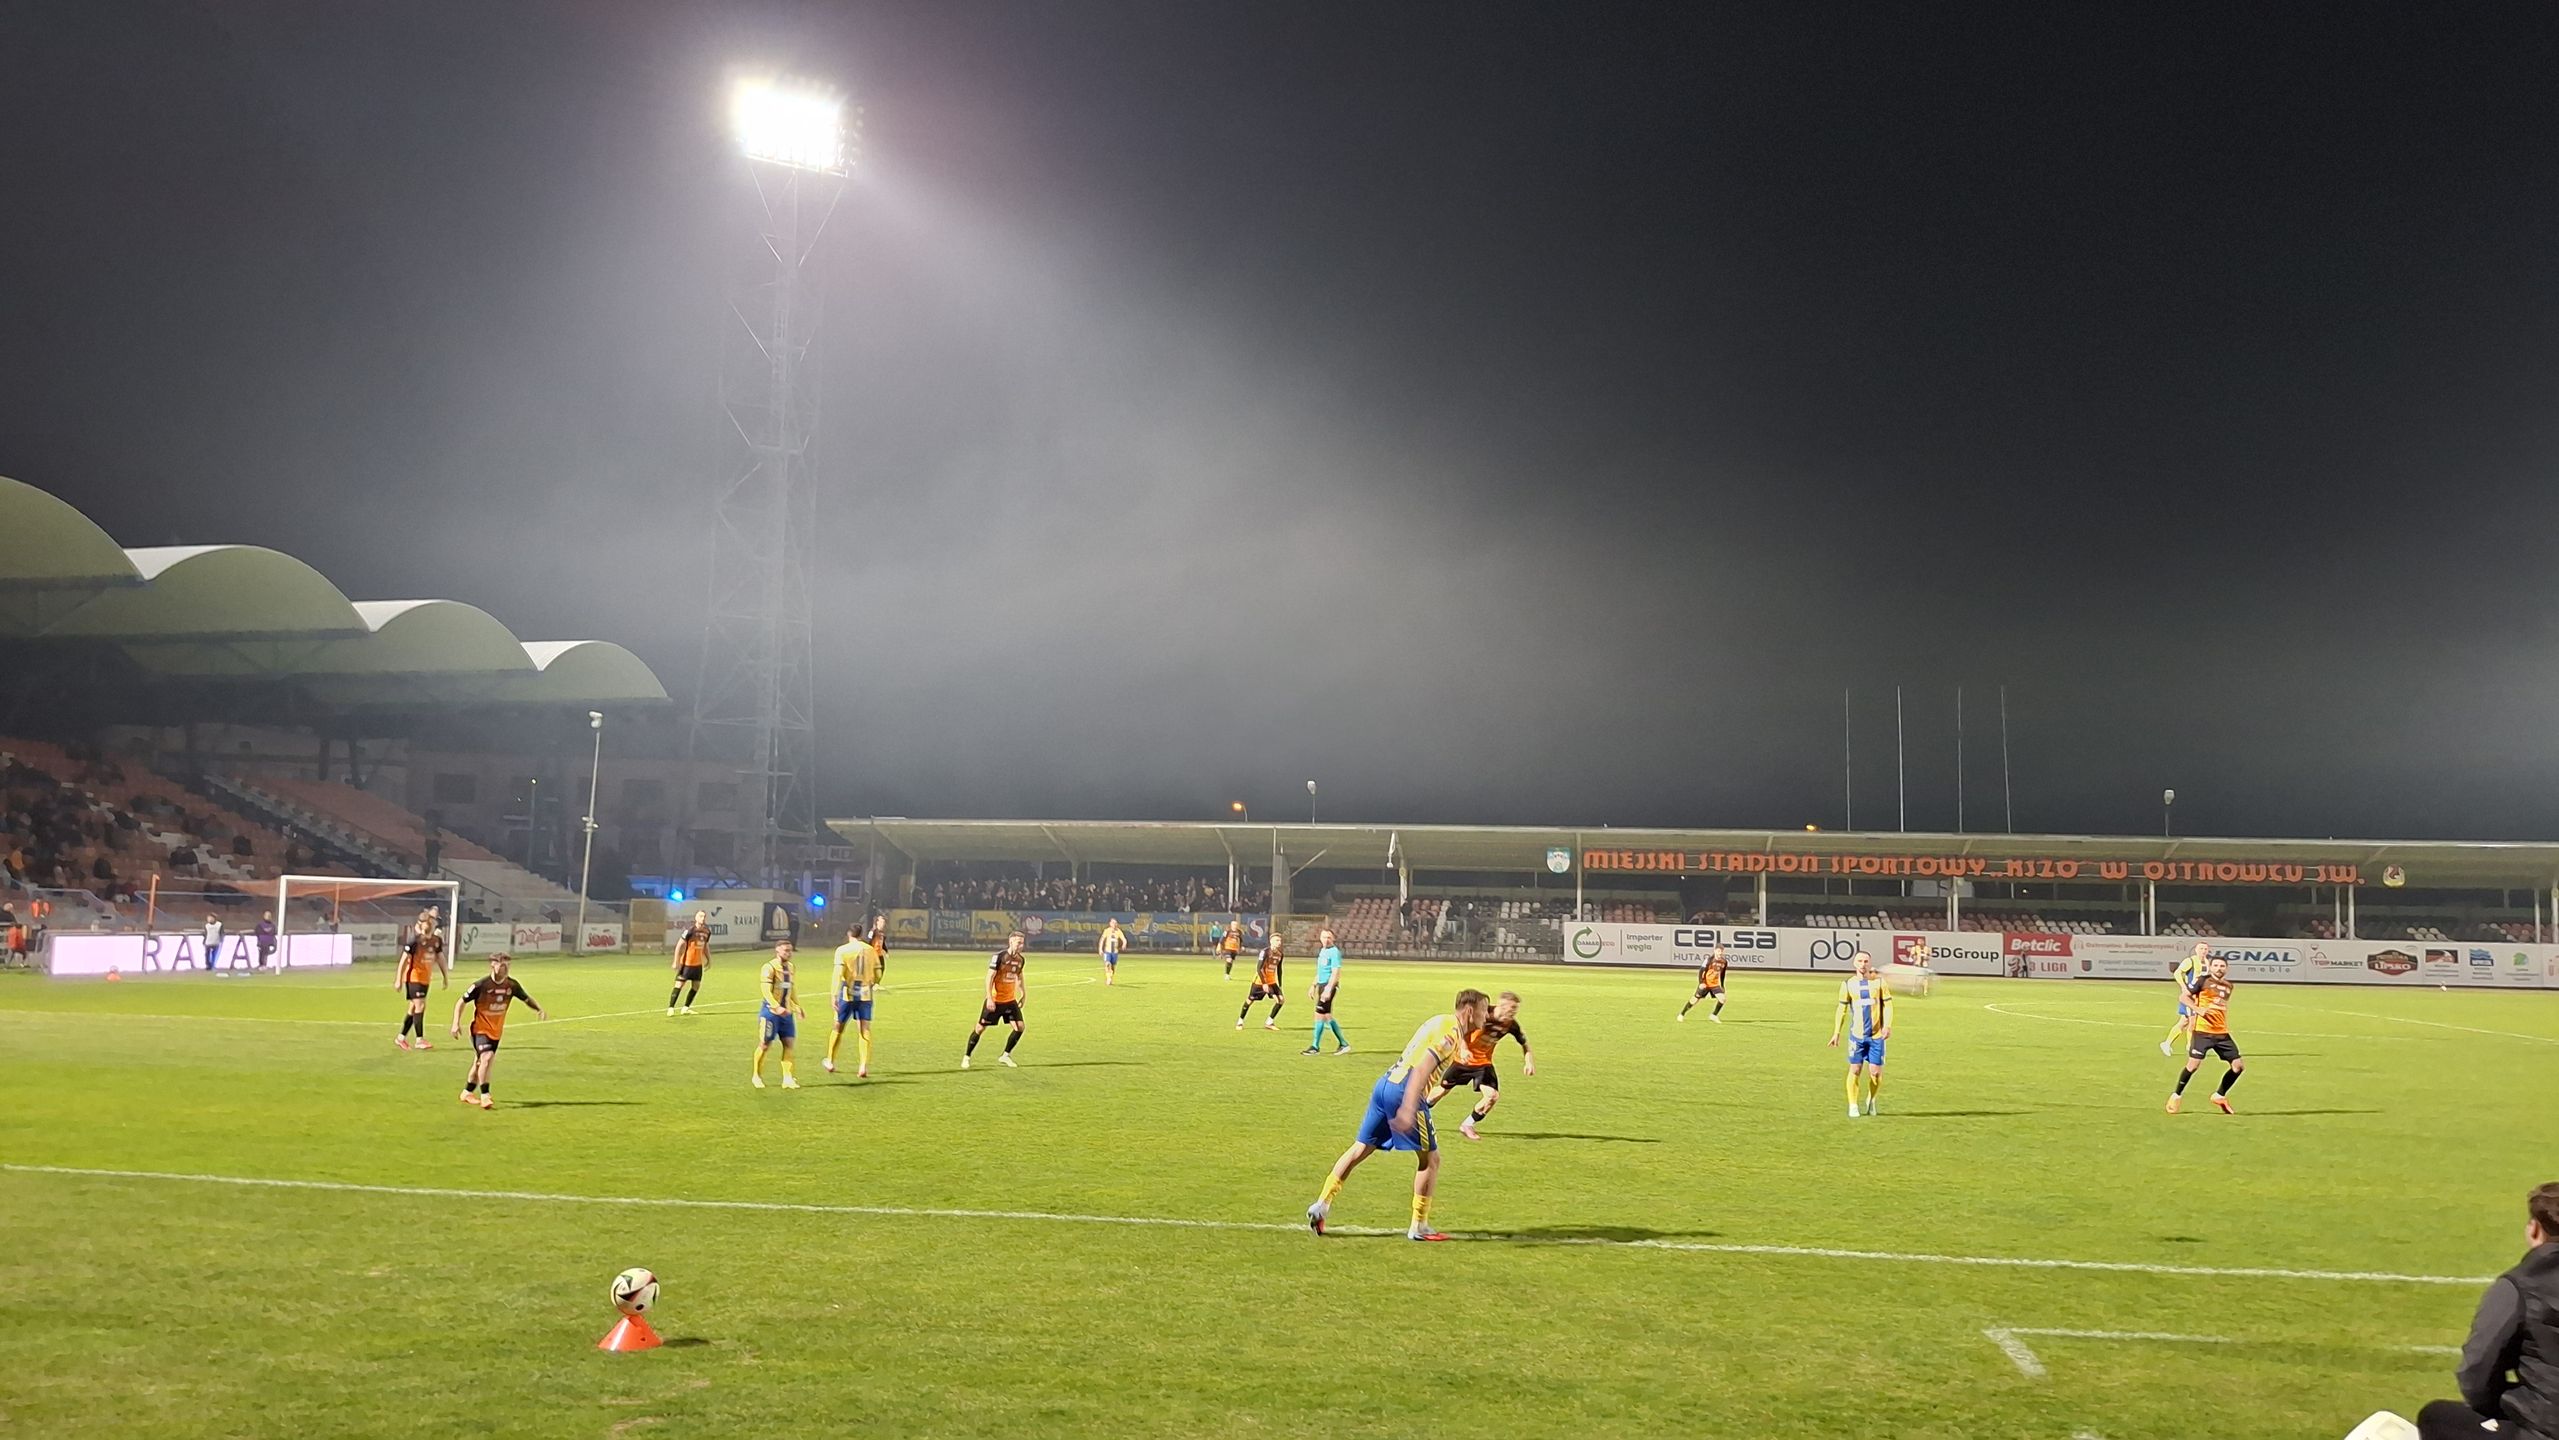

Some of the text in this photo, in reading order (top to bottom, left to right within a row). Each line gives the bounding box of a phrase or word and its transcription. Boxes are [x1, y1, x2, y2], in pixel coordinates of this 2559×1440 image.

[1583, 850, 1685, 870] MIEJSKI
[1700, 852, 1819, 873] STADION
[1832, 855, 1986, 877] SPORTOWY
[2100, 861, 2128, 880] W
[2143, 861, 2302, 882] OSTROWCU
[2011, 938, 2062, 952] Betclic
[1673, 953, 1765, 963] HUTA OROWIEC
[1931, 947, 2000, 963] 5DGroup
[2041, 962, 2067, 972] LIGA
